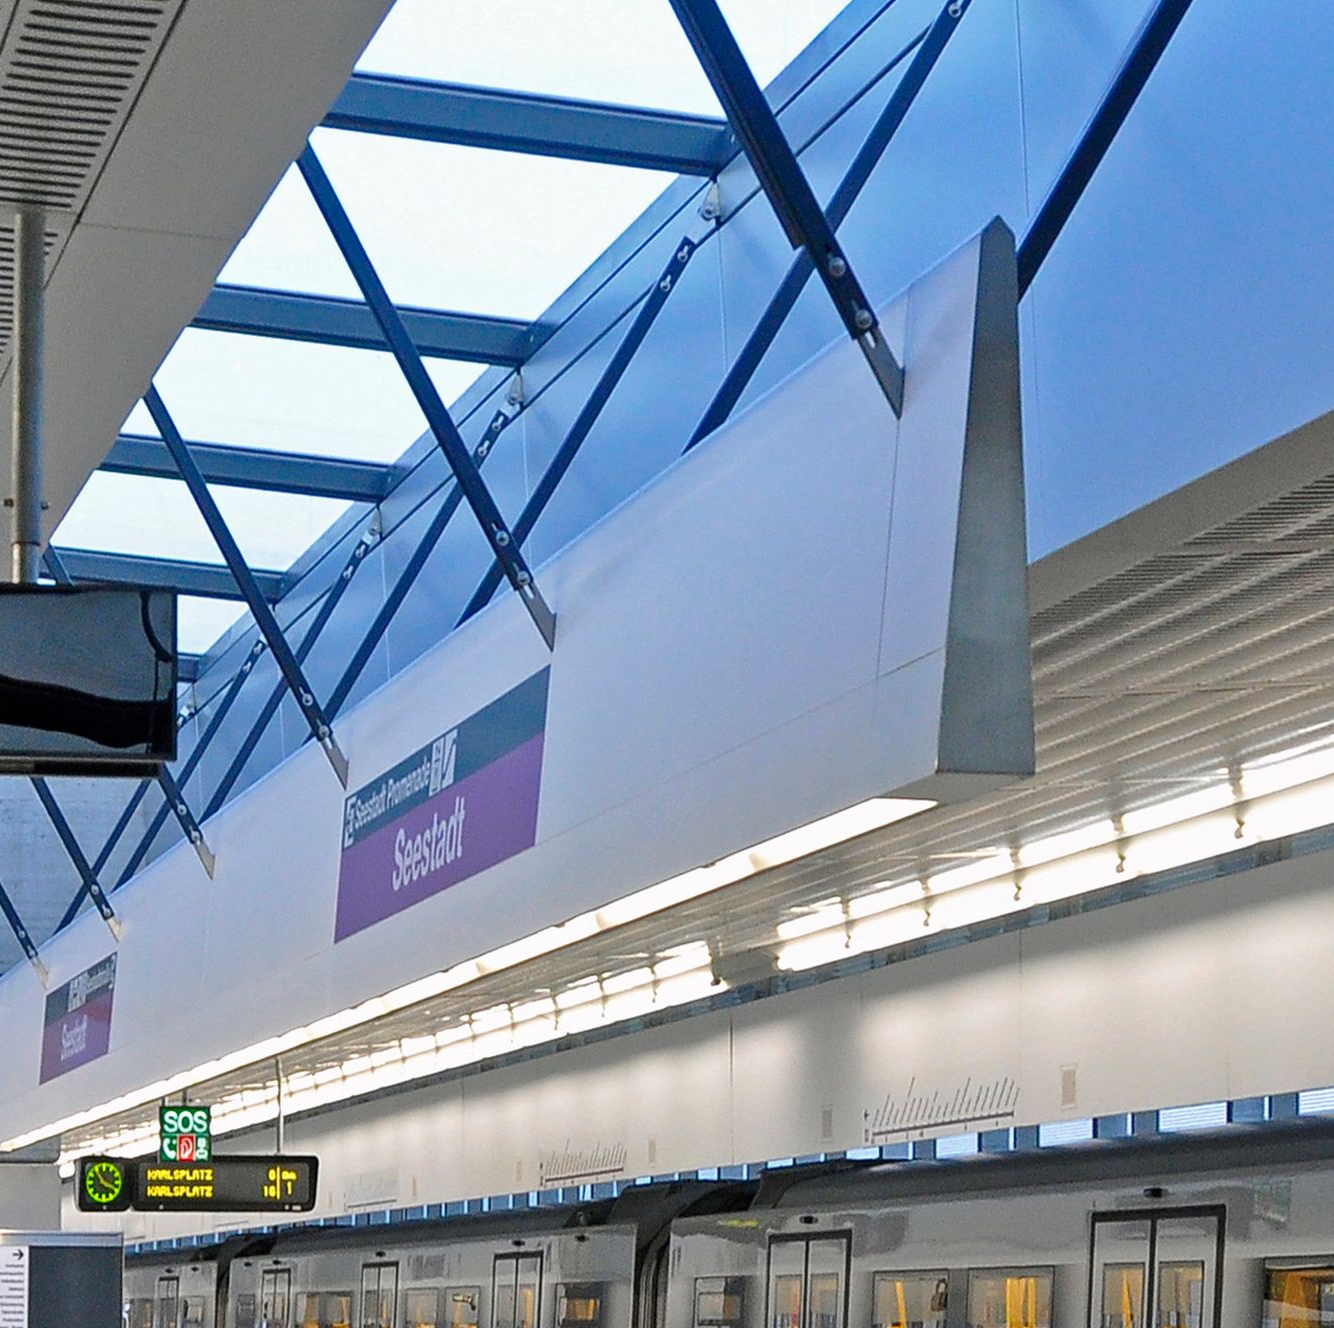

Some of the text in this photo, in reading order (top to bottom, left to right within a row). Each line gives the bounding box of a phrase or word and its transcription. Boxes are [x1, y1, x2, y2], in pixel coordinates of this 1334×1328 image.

[392, 796, 465, 891] Seestadt
[163, 1110, 208, 1133] SOS
[147, 1168, 213, 1181] KARLSPLATZ
[147, 1184, 213, 1198] KARLSPLATZ
[286, 1180, 293, 1195] 1
